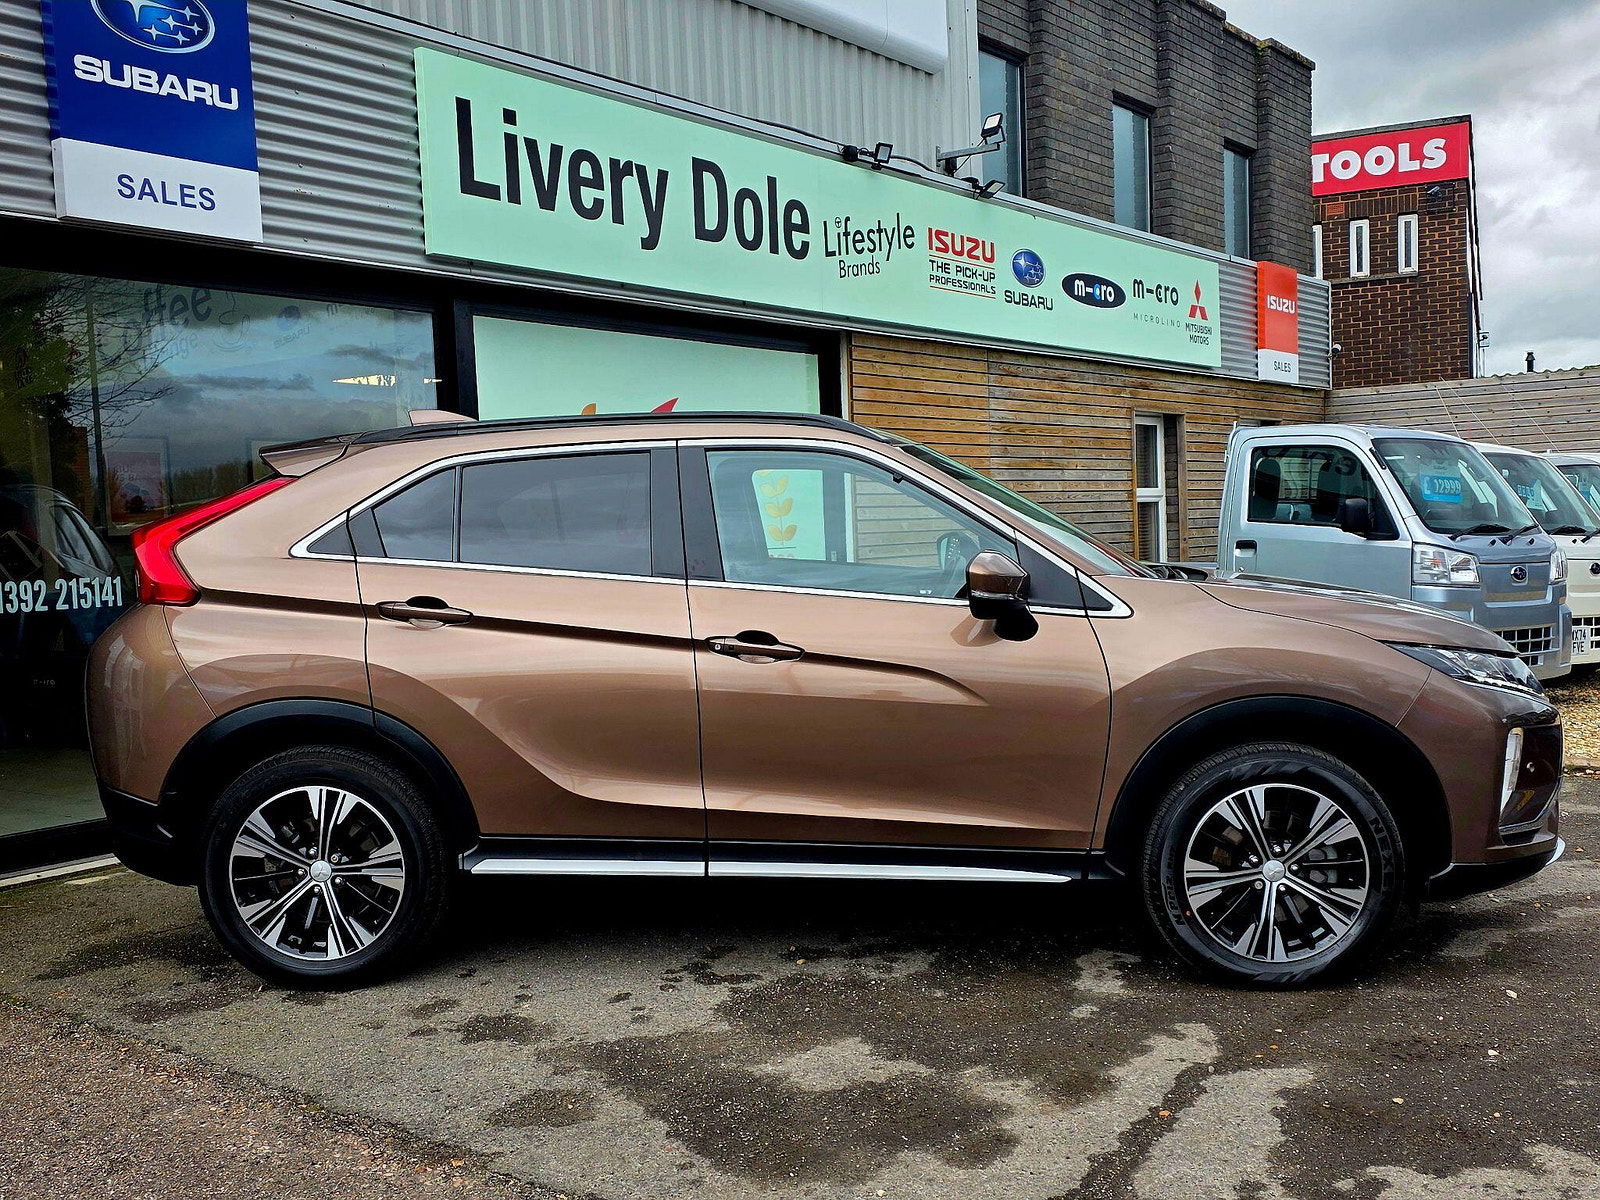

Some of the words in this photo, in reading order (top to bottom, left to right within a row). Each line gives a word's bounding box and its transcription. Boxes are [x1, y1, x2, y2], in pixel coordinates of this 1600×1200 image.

[73, 53, 239, 111] SUBARU
[1311, 137, 1447, 183] TOOLS
[454, 95, 670, 252] Livery
[691, 155, 811, 261] Dole
[117, 173, 216, 212] SALES
[822, 212, 916, 262] Lifestyle
[927, 226, 996, 264] ISUZU
[838, 255, 881, 279] Brands
[928, 259, 951, 275] THE
[955, 264, 996, 283] PICK-UP
[928, 274, 997, 295] PROFESSIONALS
[1003, 289, 1054, 311] SUBARU
[1267, 294, 1296, 315] ISUZU
[1133, 312, 1182, 328] MICROLINO
[1185, 322, 1213, 336] MITSUBISHI
[1189, 333, 1210, 346] MOTORS
[1273, 360, 1292, 373] SALES
[54, 576, 123, 611] 215141
